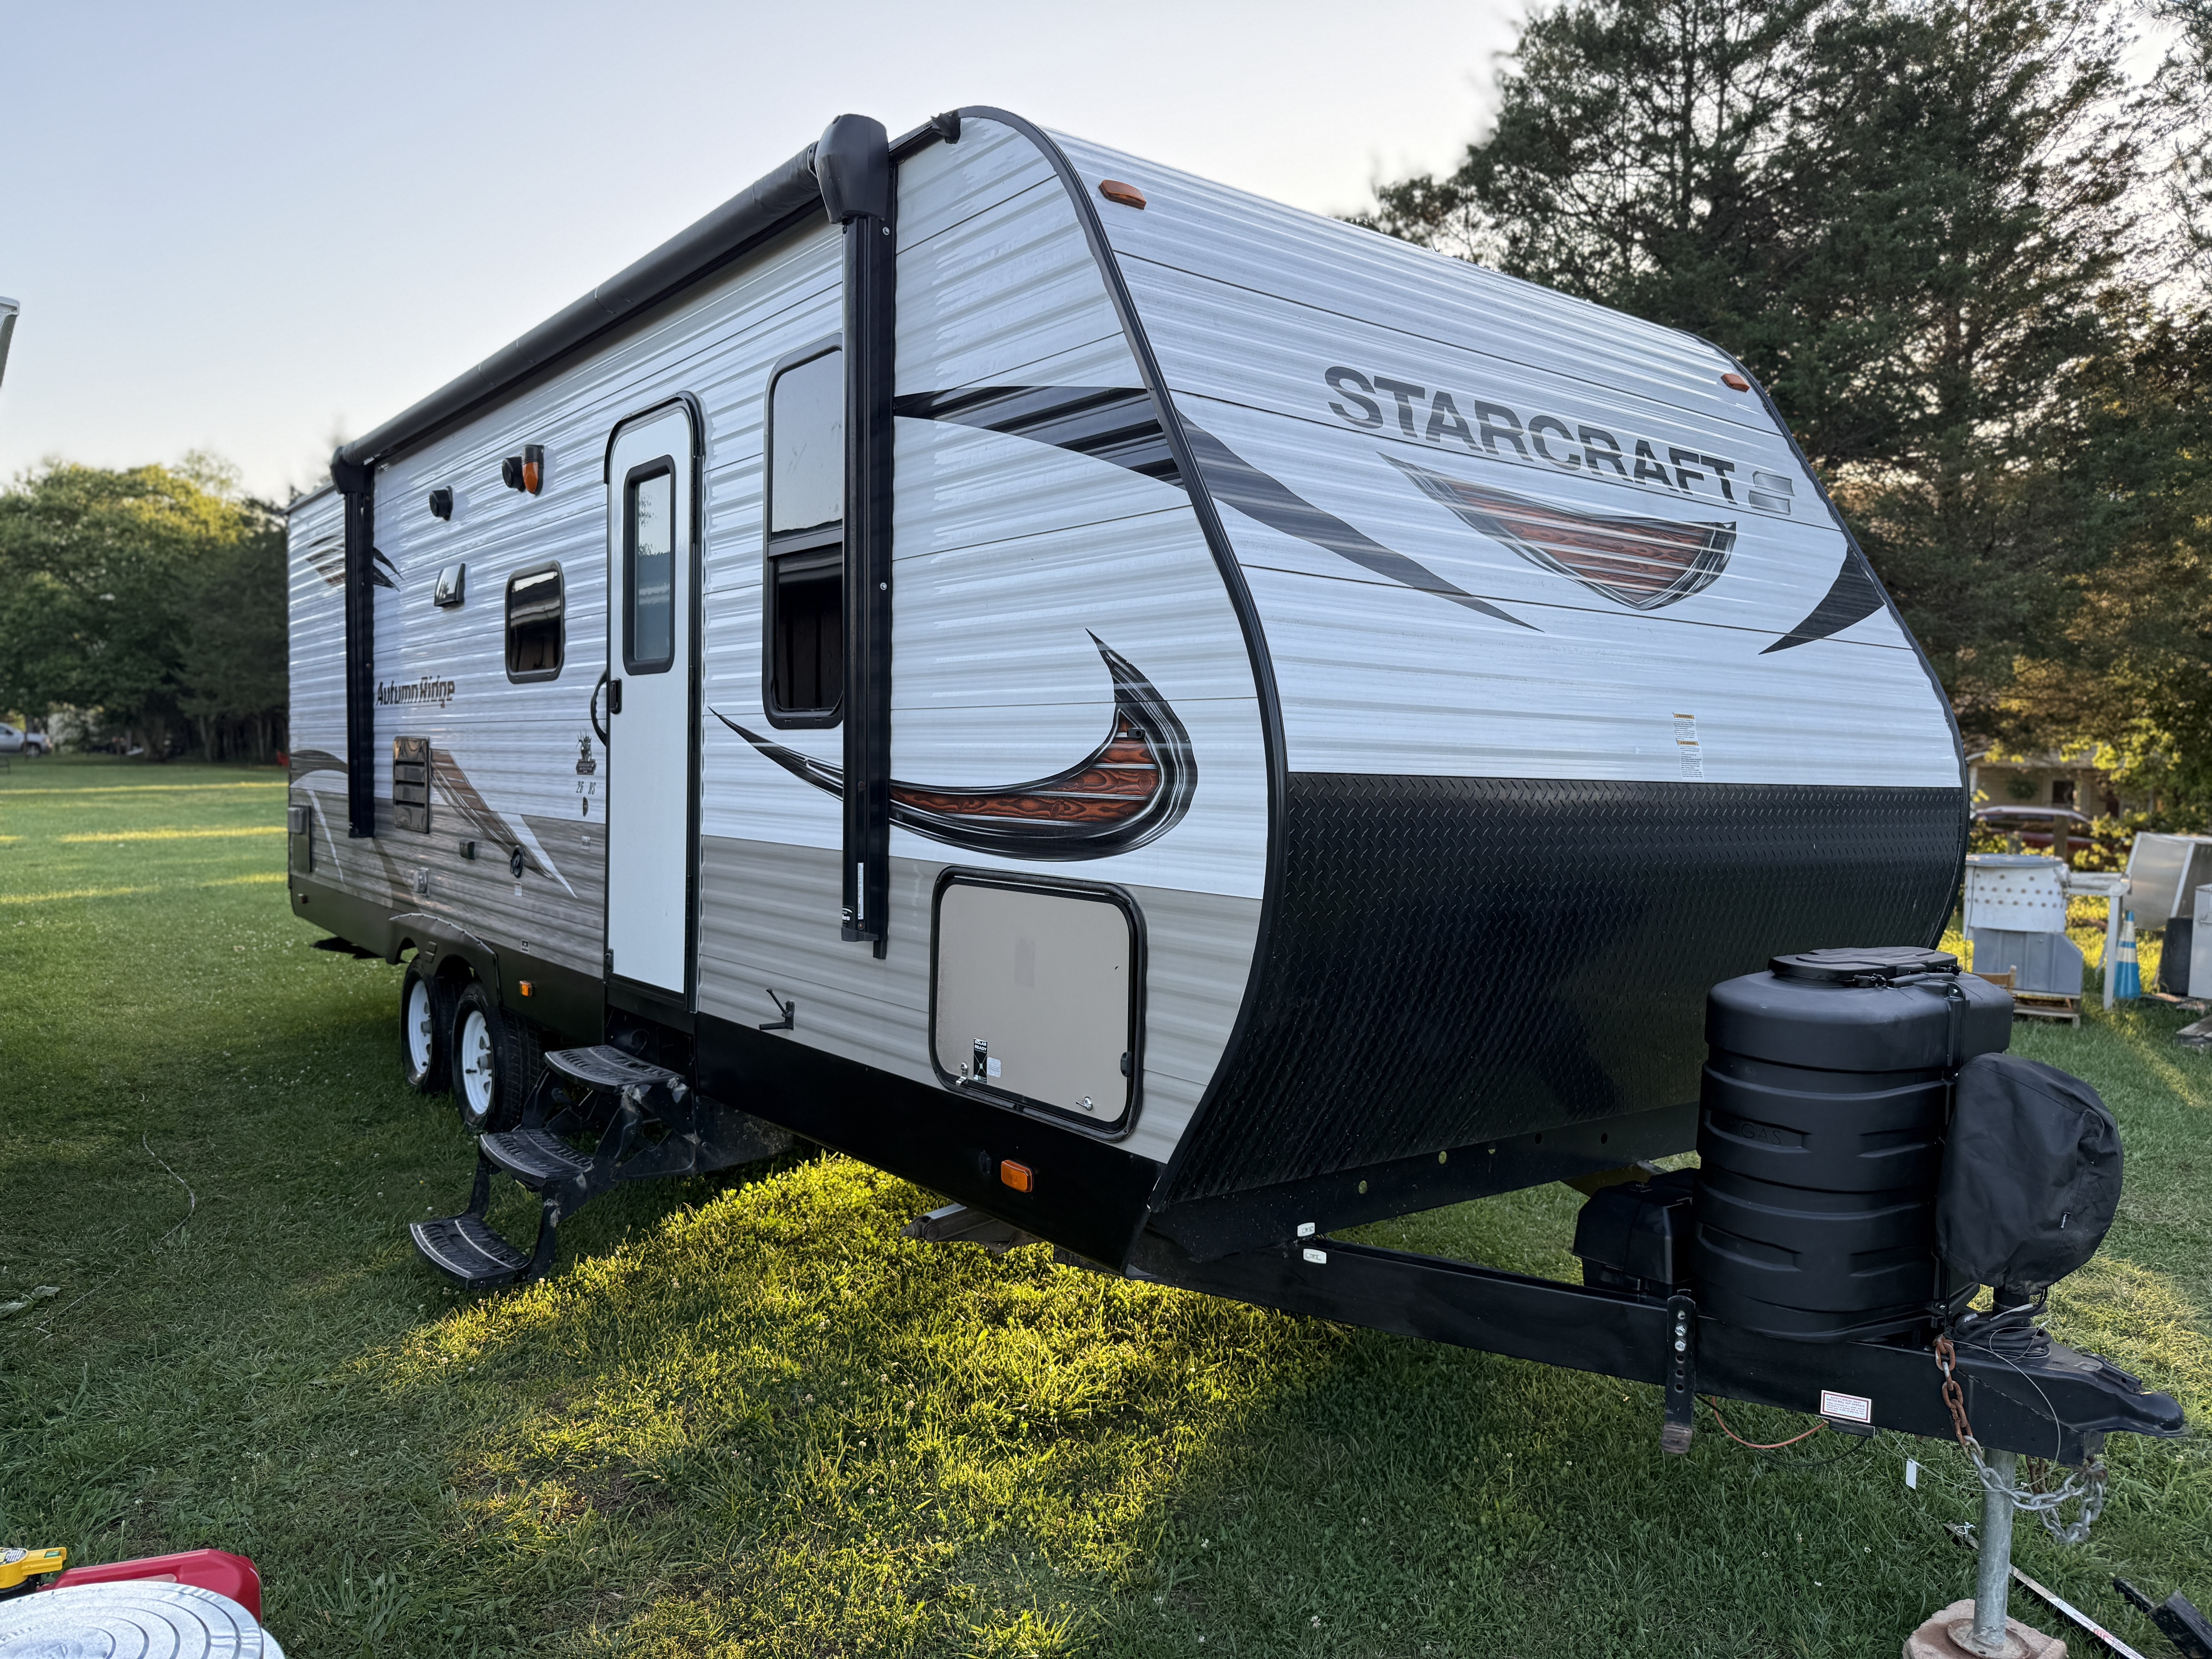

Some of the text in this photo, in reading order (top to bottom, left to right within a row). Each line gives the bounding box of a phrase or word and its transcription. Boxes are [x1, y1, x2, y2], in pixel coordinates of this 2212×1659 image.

[1324, 366, 1735, 505] STARCRAFT
[576, 781, 596, 795] 26 HS
[1741, 1123, 1782, 1145] GAS
